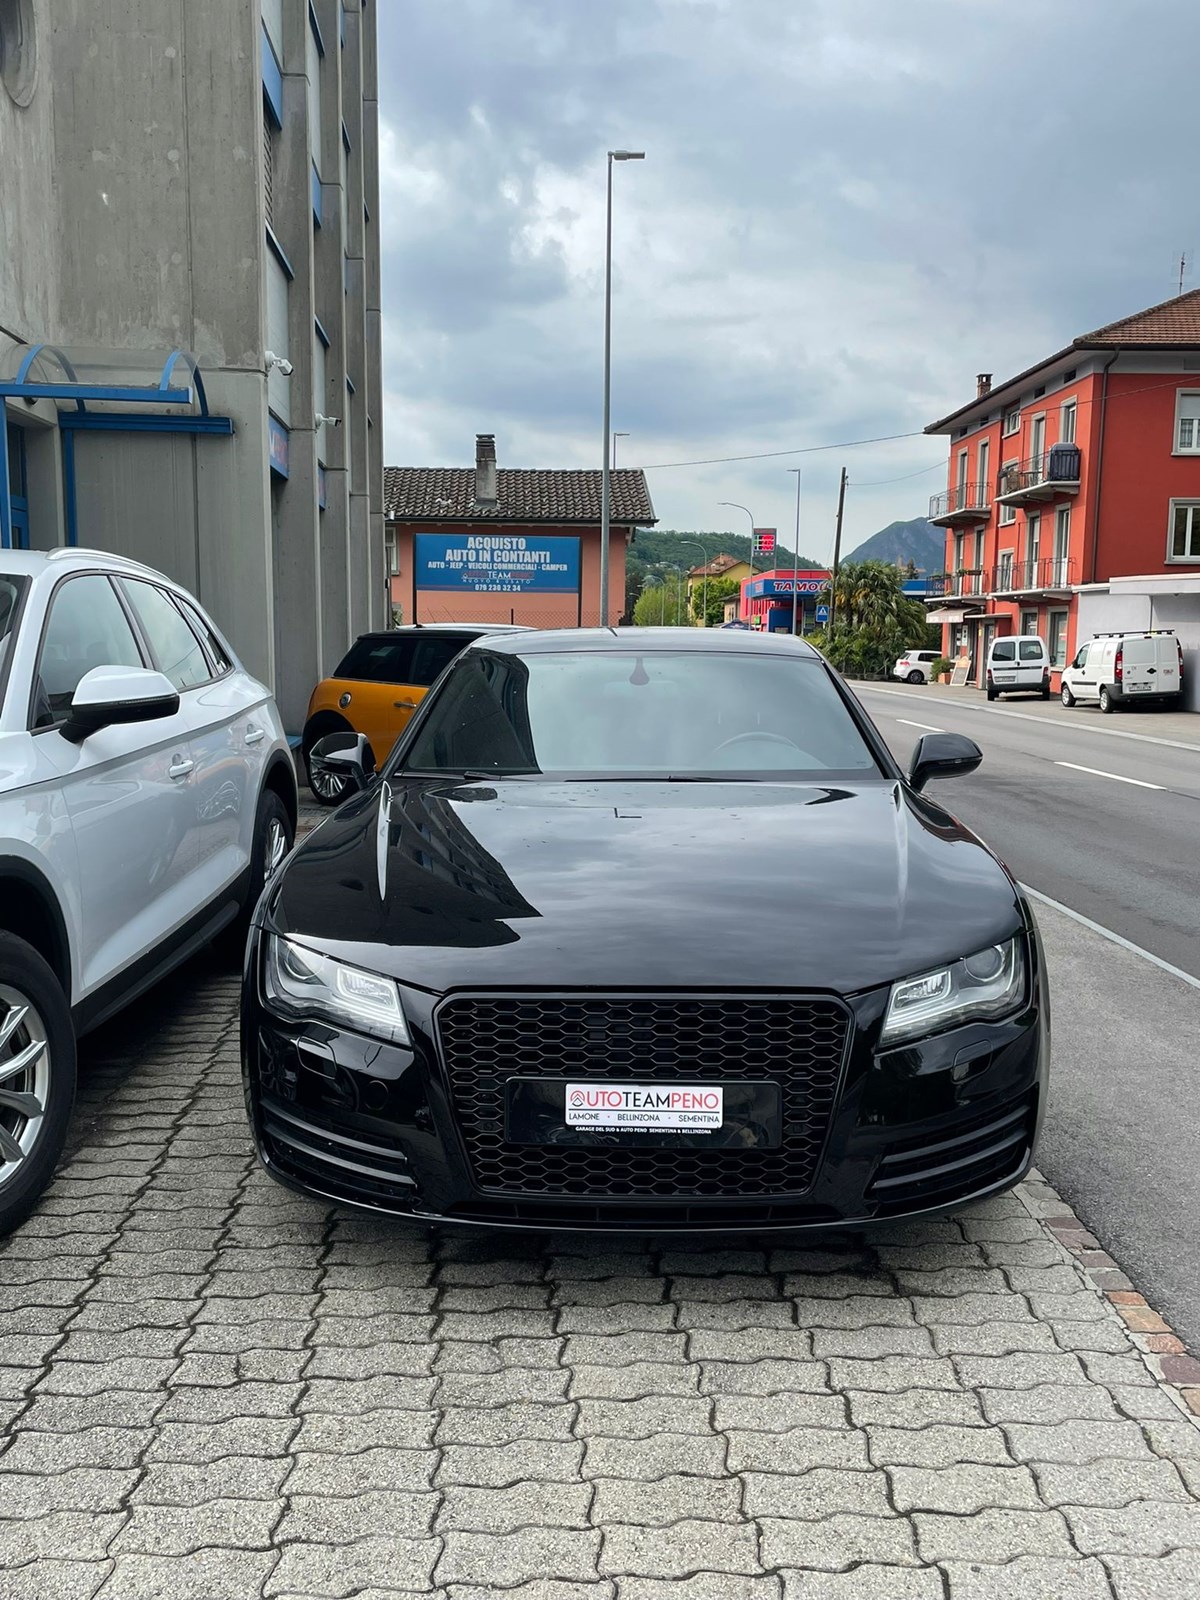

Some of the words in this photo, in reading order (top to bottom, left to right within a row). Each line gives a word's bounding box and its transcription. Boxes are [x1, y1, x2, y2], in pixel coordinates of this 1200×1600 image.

[467, 537, 526, 550] ACQUISTO
[445, 549, 476, 562] AUTO
[479, 550, 491, 562] IN
[493, 550, 551, 563] CONTANTI
[428, 561, 445, 569] AUTO
[493, 563, 538, 571] COMMERCIALI
[678, 1115, 720, 1123] SEMENTINA
